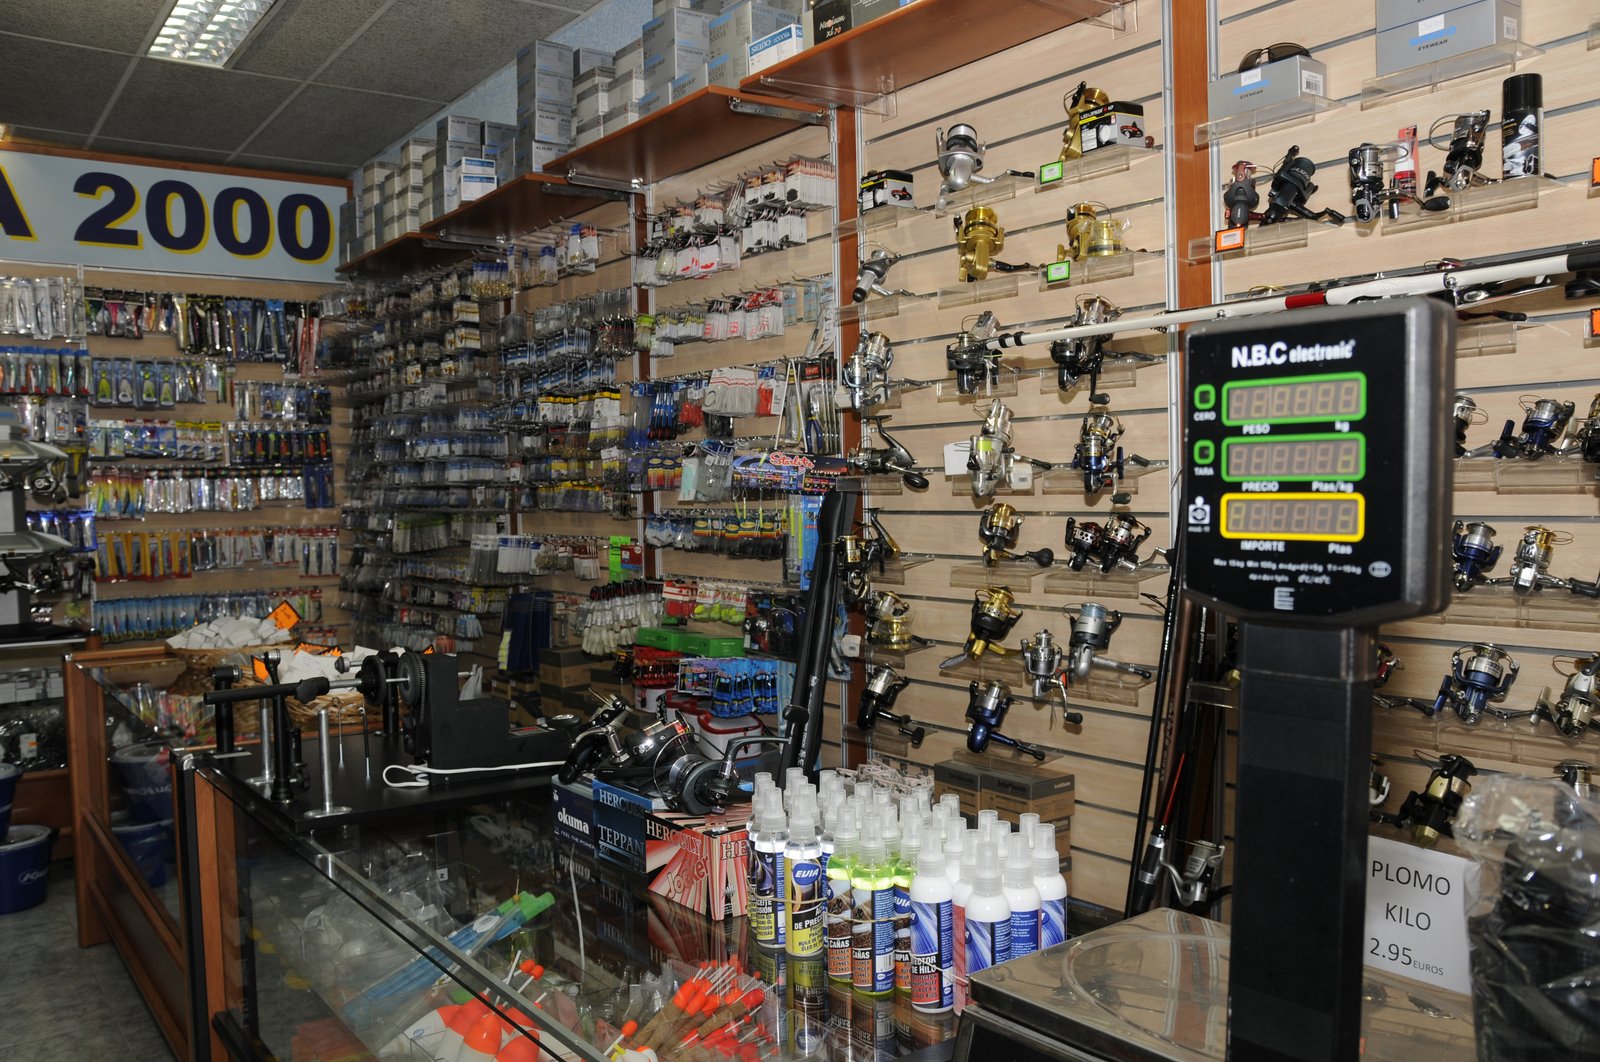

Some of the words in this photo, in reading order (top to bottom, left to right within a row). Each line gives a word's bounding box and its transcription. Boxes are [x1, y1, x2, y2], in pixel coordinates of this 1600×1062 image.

[1418, 39, 1449, 51] EYEWEAR
[1240, 89, 1264, 99] EYEWEAR
[73, 171, 334, 264] 2000
[1193, 411, 1217, 421] CERO
[1242, 423, 1271, 435] PESO
[1194, 467, 1214, 476] TARA
[1242, 481, 1279, 492] PRECIO
[1240, 540, 1286, 552] IMPORTE
[557, 806, 591, 835] okuma
[598, 823, 646, 857] TEPPAN
[1372, 860, 1451, 895] PLOMO
[1385, 902, 1431, 931] KILO
[794, 921, 803, 930] DE
[829, 939, 850, 948] CAÑAS
[1370, 937, 1412, 966] 2.95
[1412, 960, 1444, 976] EUROS
[920, 964, 937, 973] HILO
